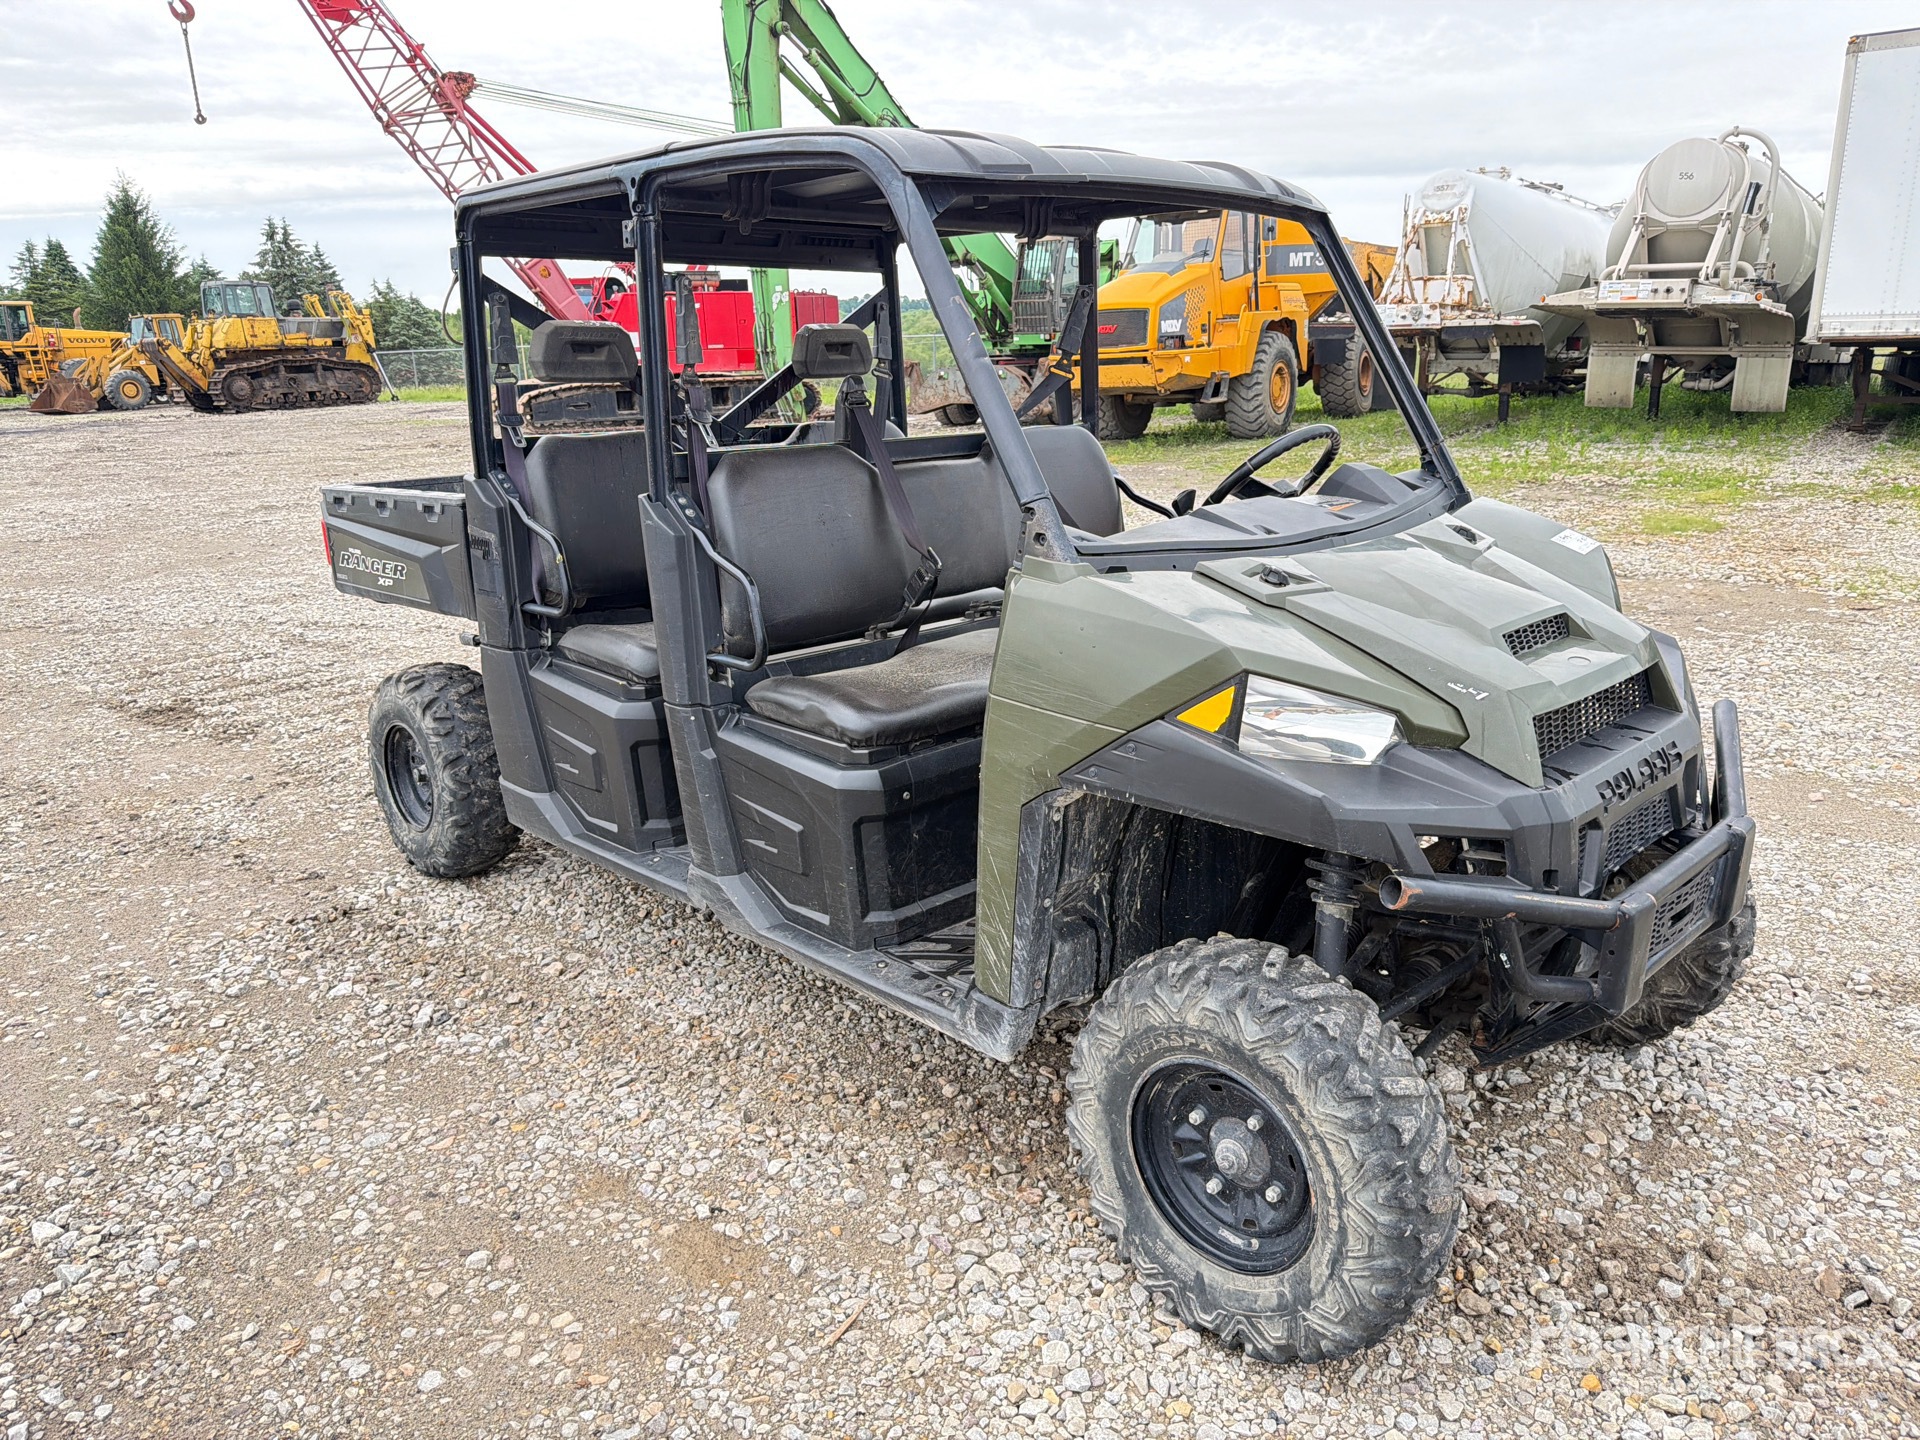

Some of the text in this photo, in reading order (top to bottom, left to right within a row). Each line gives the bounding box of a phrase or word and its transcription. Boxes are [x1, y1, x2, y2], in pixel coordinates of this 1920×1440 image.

[1678, 171, 1695, 181] 556
[339, 551, 407, 579] RANGER
[377, 576, 394, 587] XP
[1595, 740, 1683, 814] POLARIS
